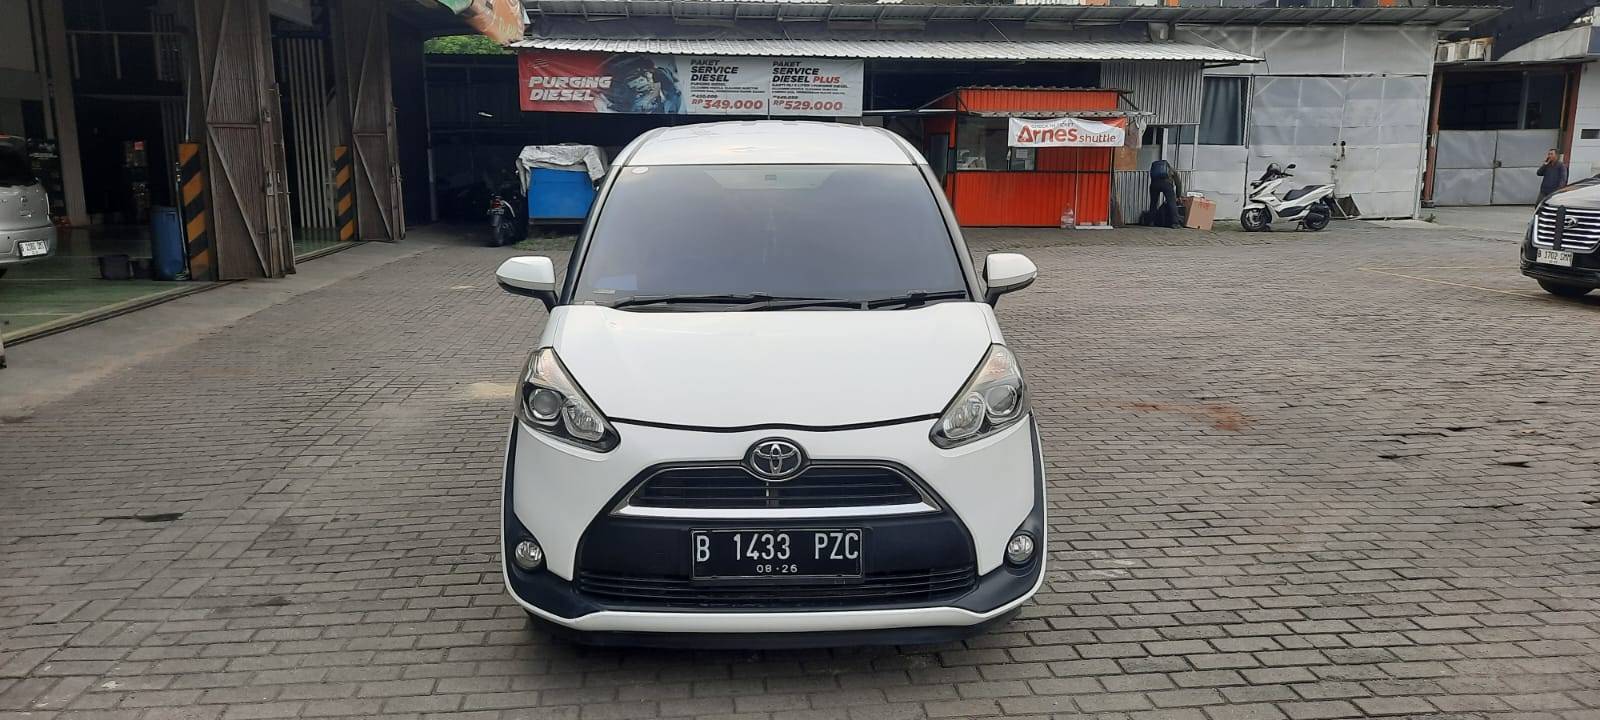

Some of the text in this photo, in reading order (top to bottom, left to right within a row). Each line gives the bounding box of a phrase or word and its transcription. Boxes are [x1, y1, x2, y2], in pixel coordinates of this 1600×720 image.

[690, 66, 739, 74] SERVICE
[772, 67, 820, 75] SERVICE
[528, 76, 612, 89] PURGING
[690, 74, 729, 82] DIESEL
[772, 75, 840, 84] DIESEL PLUS
[529, 89, 594, 101] DIESEL
[1017, 125, 1078, 143] Arnes
[1079, 134, 1117, 143] shuttle
[696, 532, 859, 562] B 1433 PZC
